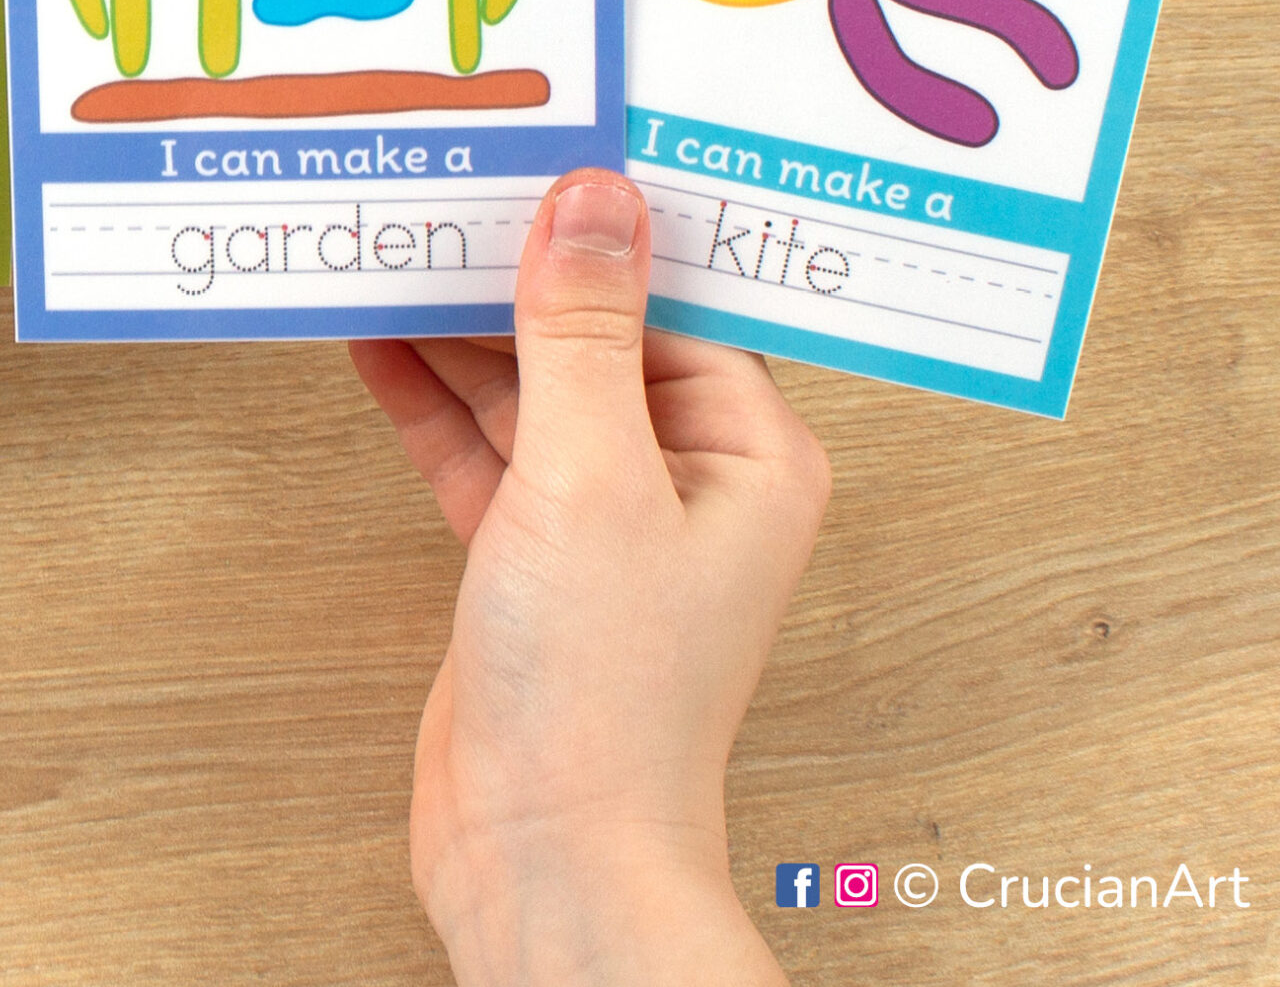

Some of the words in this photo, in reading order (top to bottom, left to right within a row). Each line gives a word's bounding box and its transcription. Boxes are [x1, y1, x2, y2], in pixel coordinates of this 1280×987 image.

[160, 138, 179, 176] I
[194, 144, 283, 177] can
[297, 134, 428, 175] make
[444, 143, 474, 173] a
[640, 118, 665, 157] I
[675, 136, 762, 181] can
[778, 162, 910, 211] make
[925, 189, 954, 221] a
[171, 202, 468, 295] garden
[706, 199, 851, 296] kite
